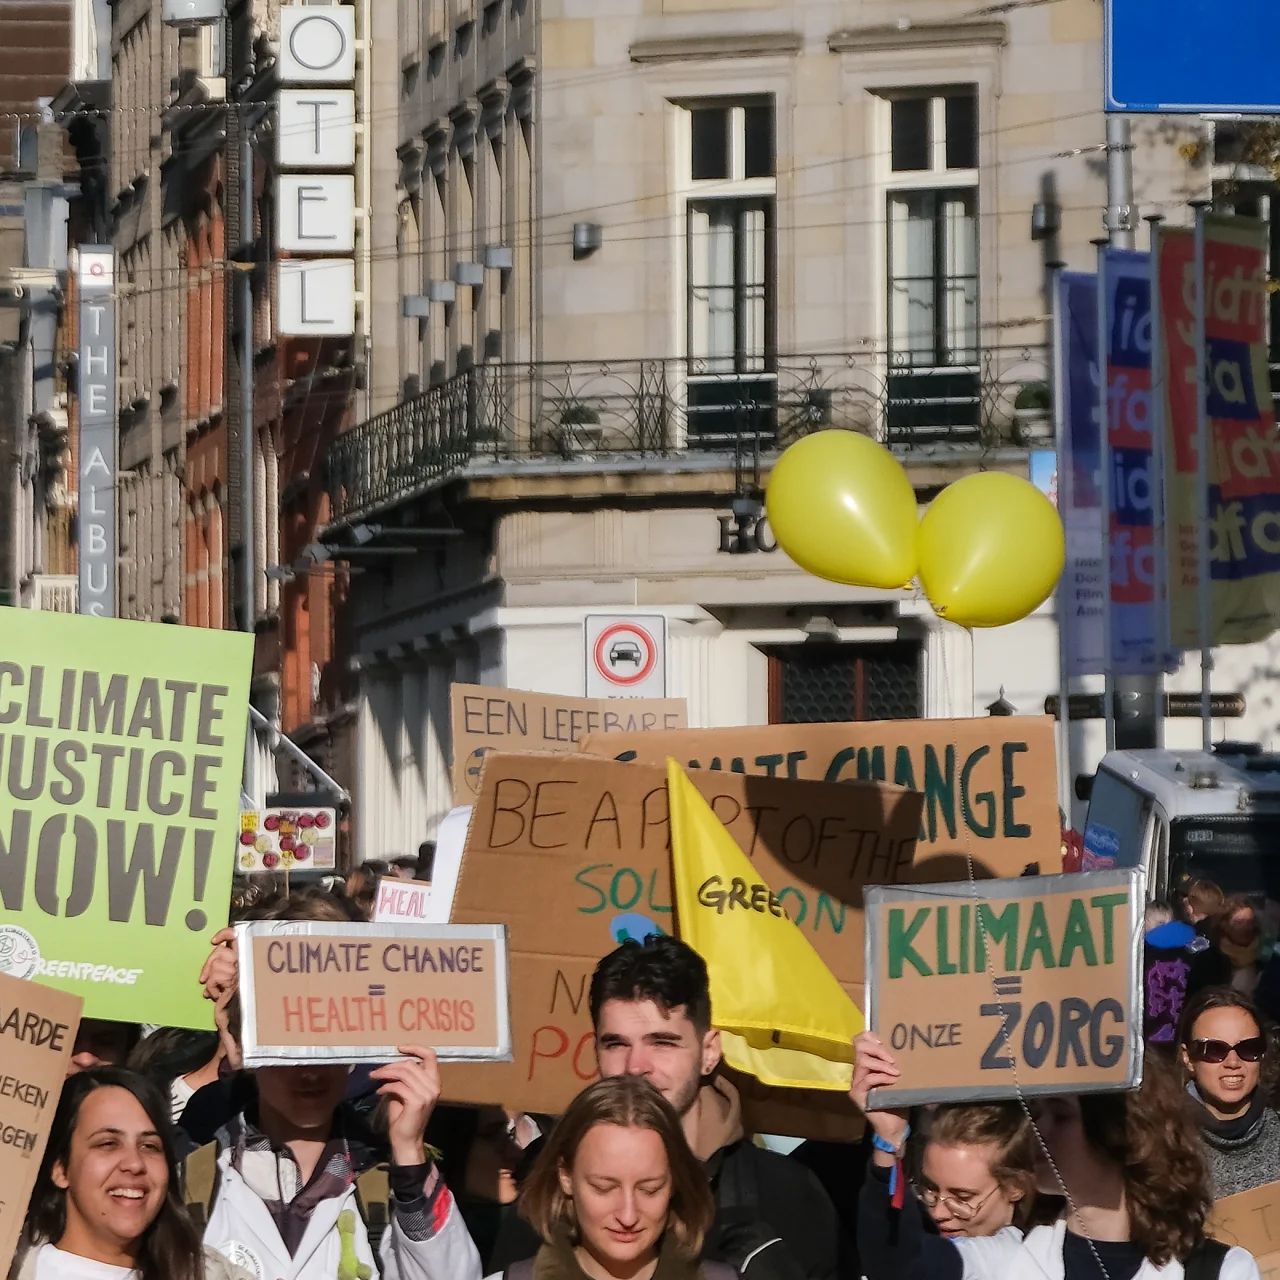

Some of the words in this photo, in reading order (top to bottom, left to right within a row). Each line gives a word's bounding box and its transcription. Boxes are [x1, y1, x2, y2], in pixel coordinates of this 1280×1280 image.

[288, 14, 347, 326] OTEL
[85, 305, 109, 416] THE
[462, 695, 528, 737] EEN
[542, 706, 679, 744] LEEFBARE
[488, 778, 579, 849] BE
[584, 790, 622, 849] A
[780, 814, 846, 866] OF
[378, 884, 432, 920] HEAL
[697, 875, 792, 921] GREE
[267, 940, 372, 974] CLIMATE
[382, 943, 485, 974] CHANGE
[886, 892, 1130, 980] KLIMAAT
[36, 956, 144, 985] REENPEACE
[368, 984, 386, 996] =
[992, 975, 1023, 997] =
[282, 995, 387, 1033] HEALTH
[397, 997, 476, 1032] CRISIS
[889, 1022, 964, 1052] ONZE
[978, 996, 1125, 1071] ZORG
